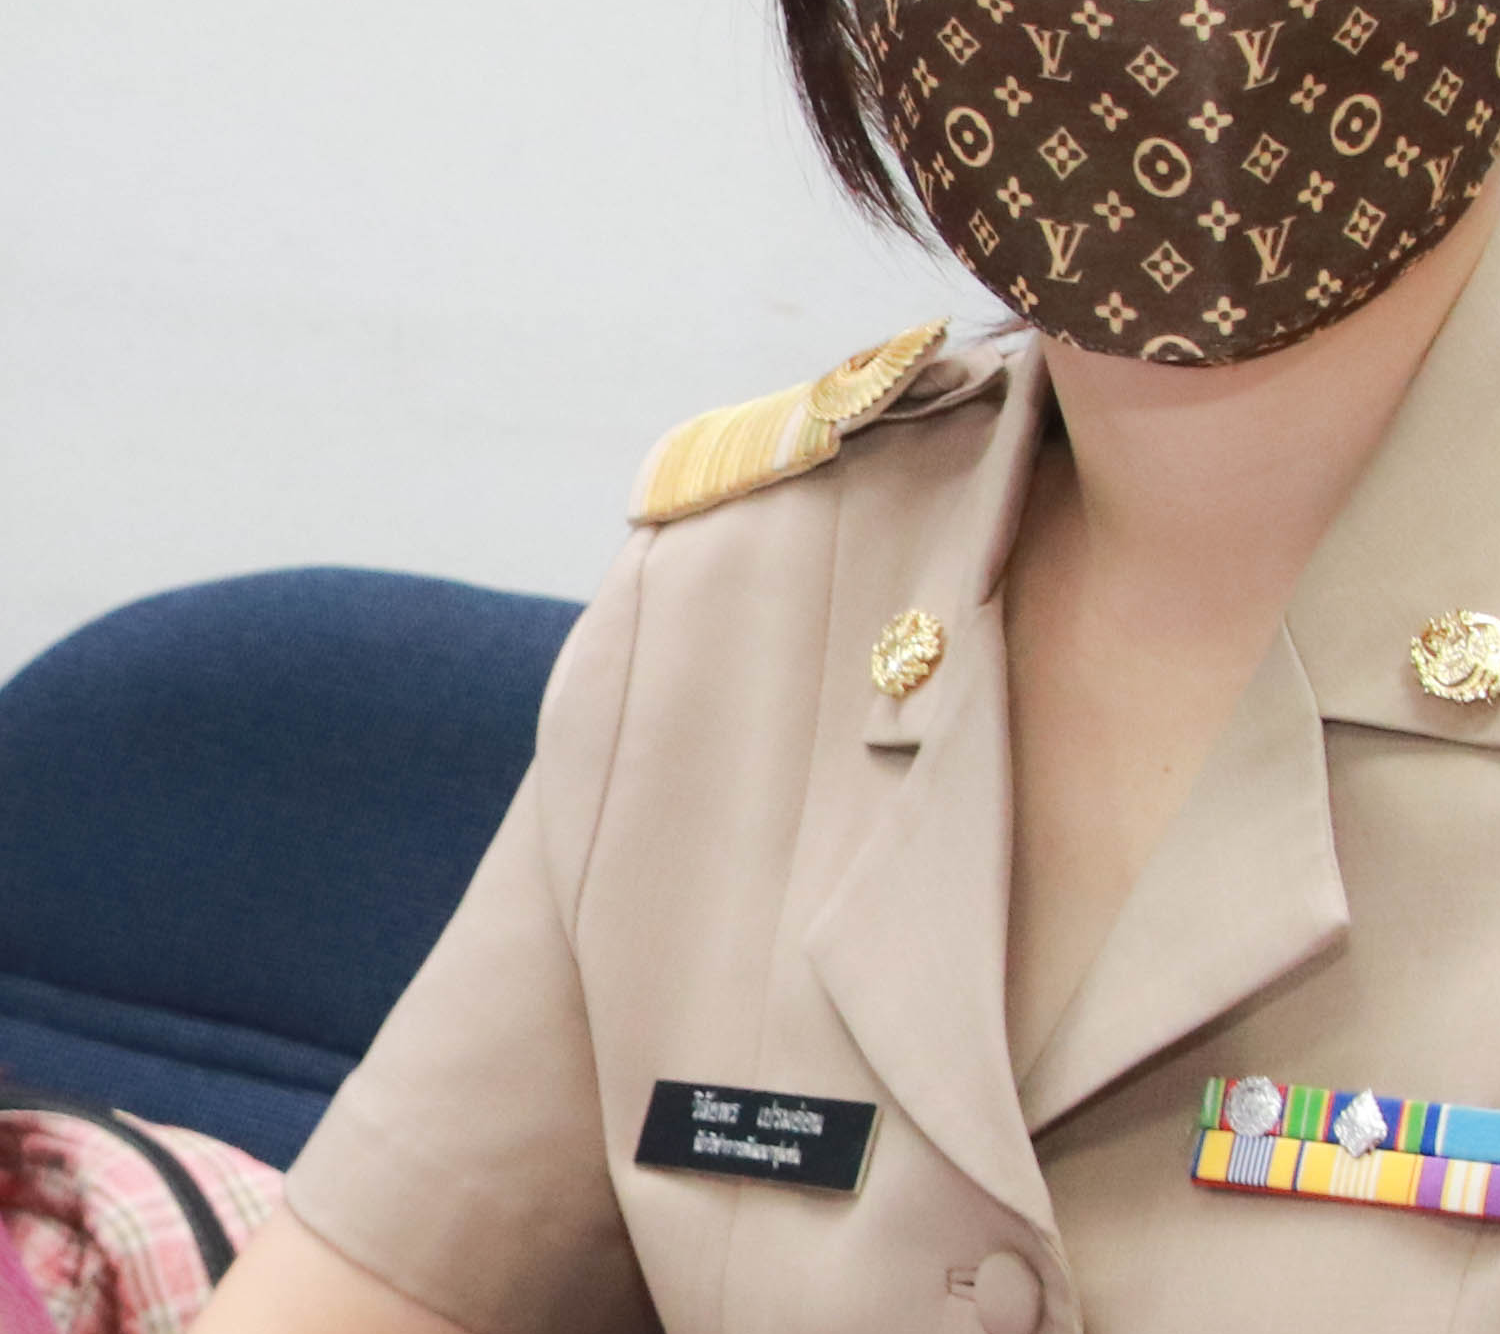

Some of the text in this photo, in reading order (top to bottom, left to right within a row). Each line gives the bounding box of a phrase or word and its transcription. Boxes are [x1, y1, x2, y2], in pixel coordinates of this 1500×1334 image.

[1021, 22, 1073, 83] LV
[1229, 20, 1286, 91] LV
[1035, 218, 1091, 284] LV
[1243, 216, 1297, 286] LV
